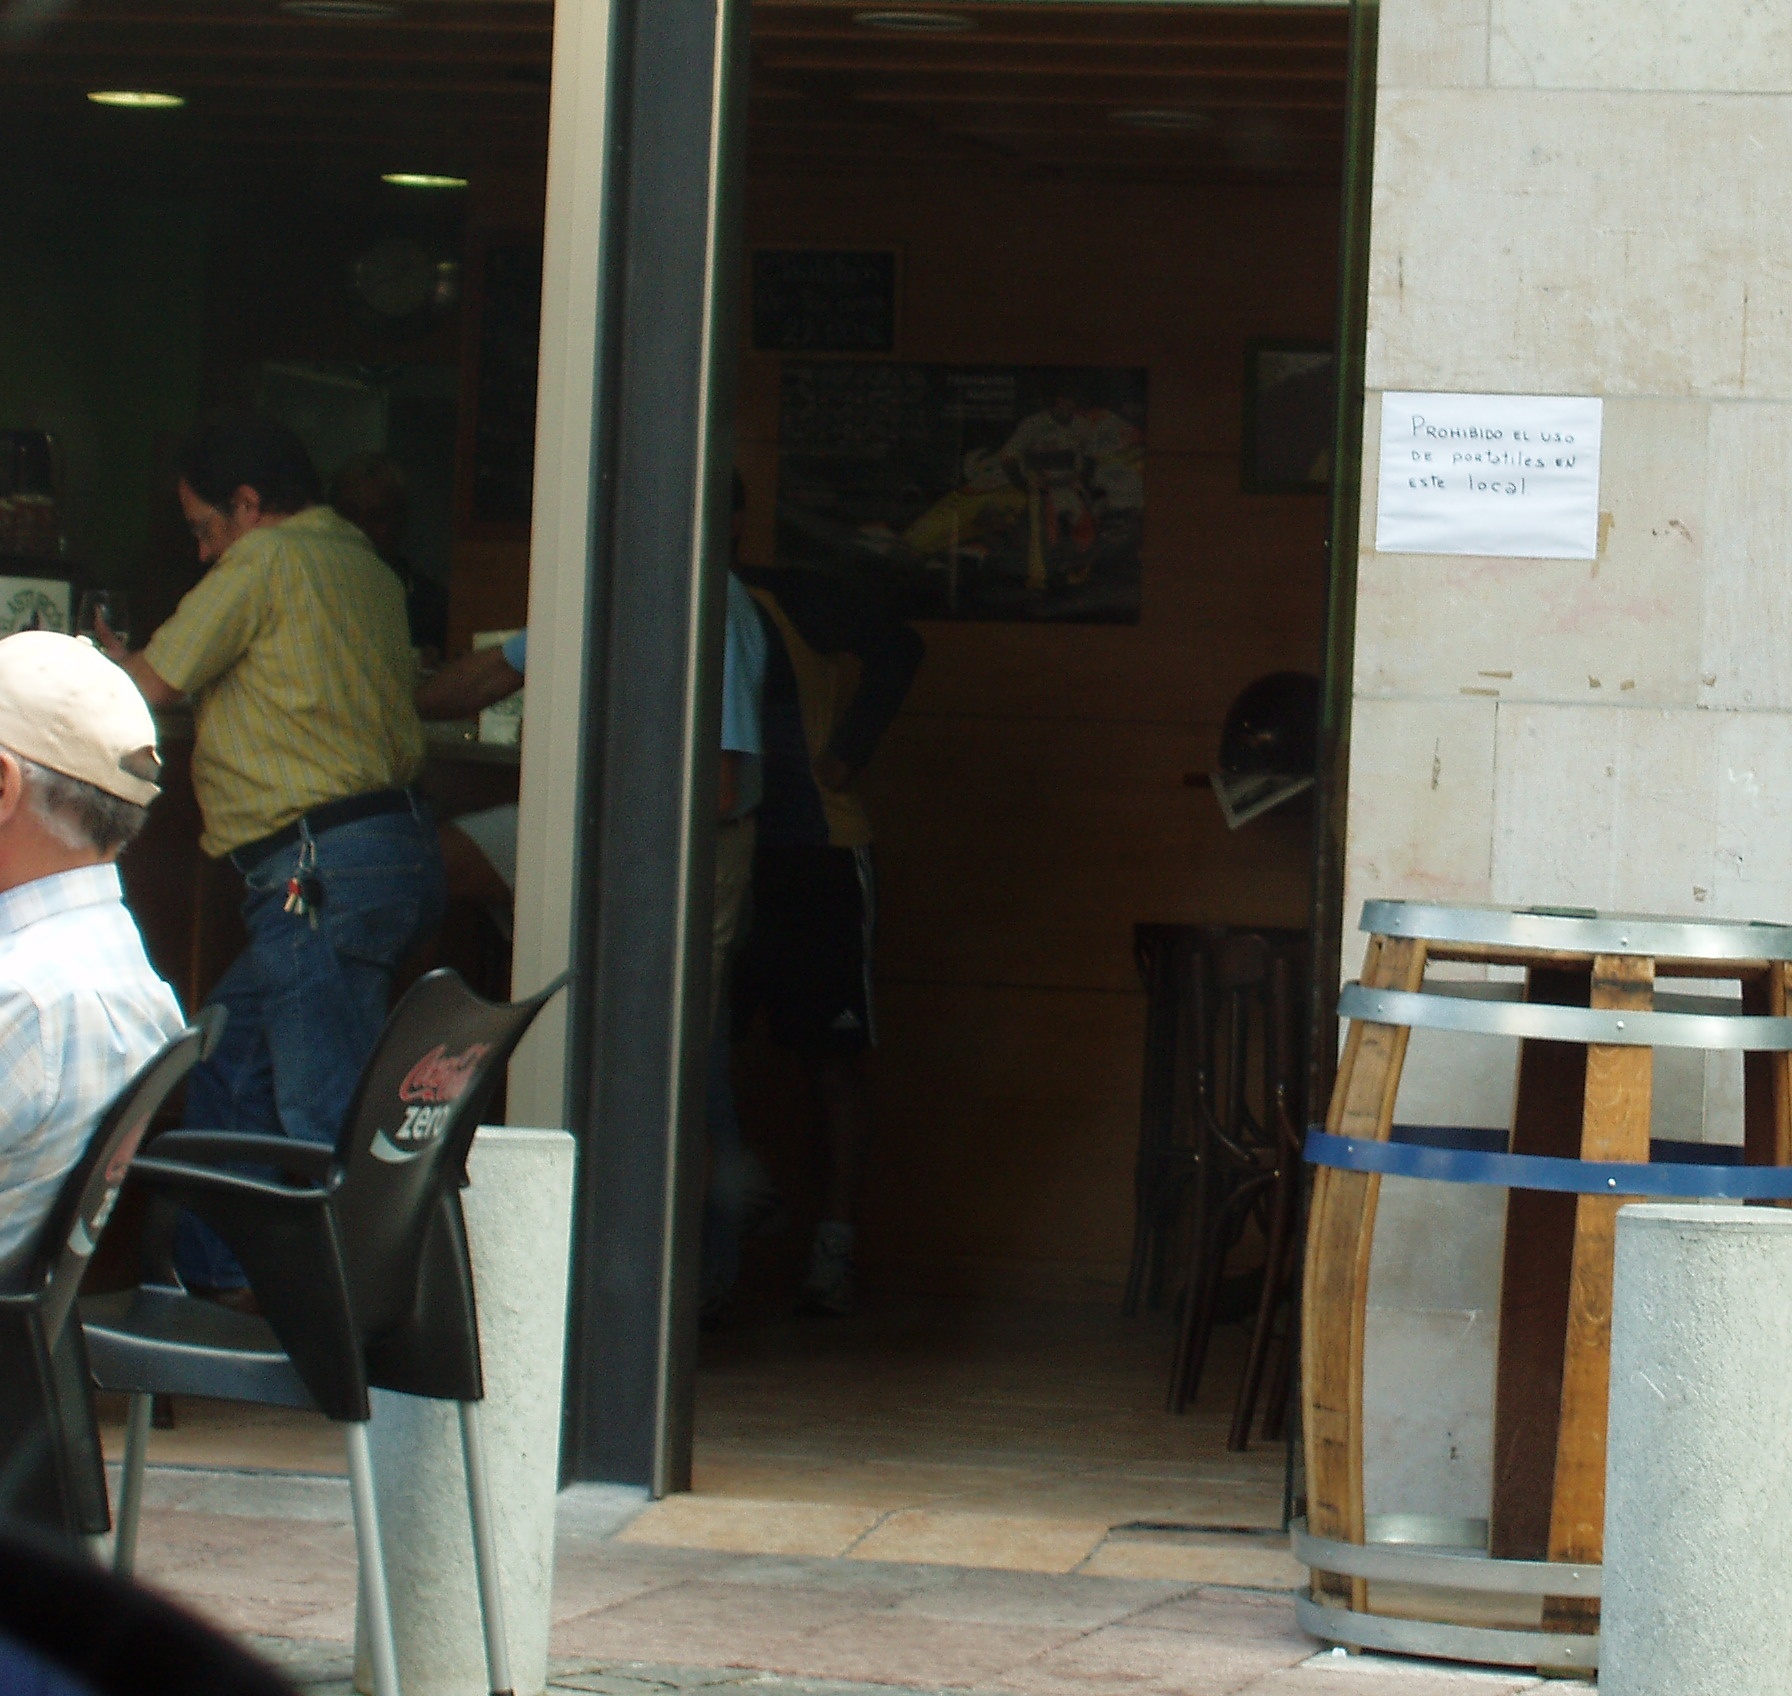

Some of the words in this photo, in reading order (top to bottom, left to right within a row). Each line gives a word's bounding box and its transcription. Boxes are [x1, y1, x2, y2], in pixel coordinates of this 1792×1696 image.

[1513, 431, 1530, 441] EL
[1412, 450, 1431, 461] DE
[1469, 474, 1526, 494] local
